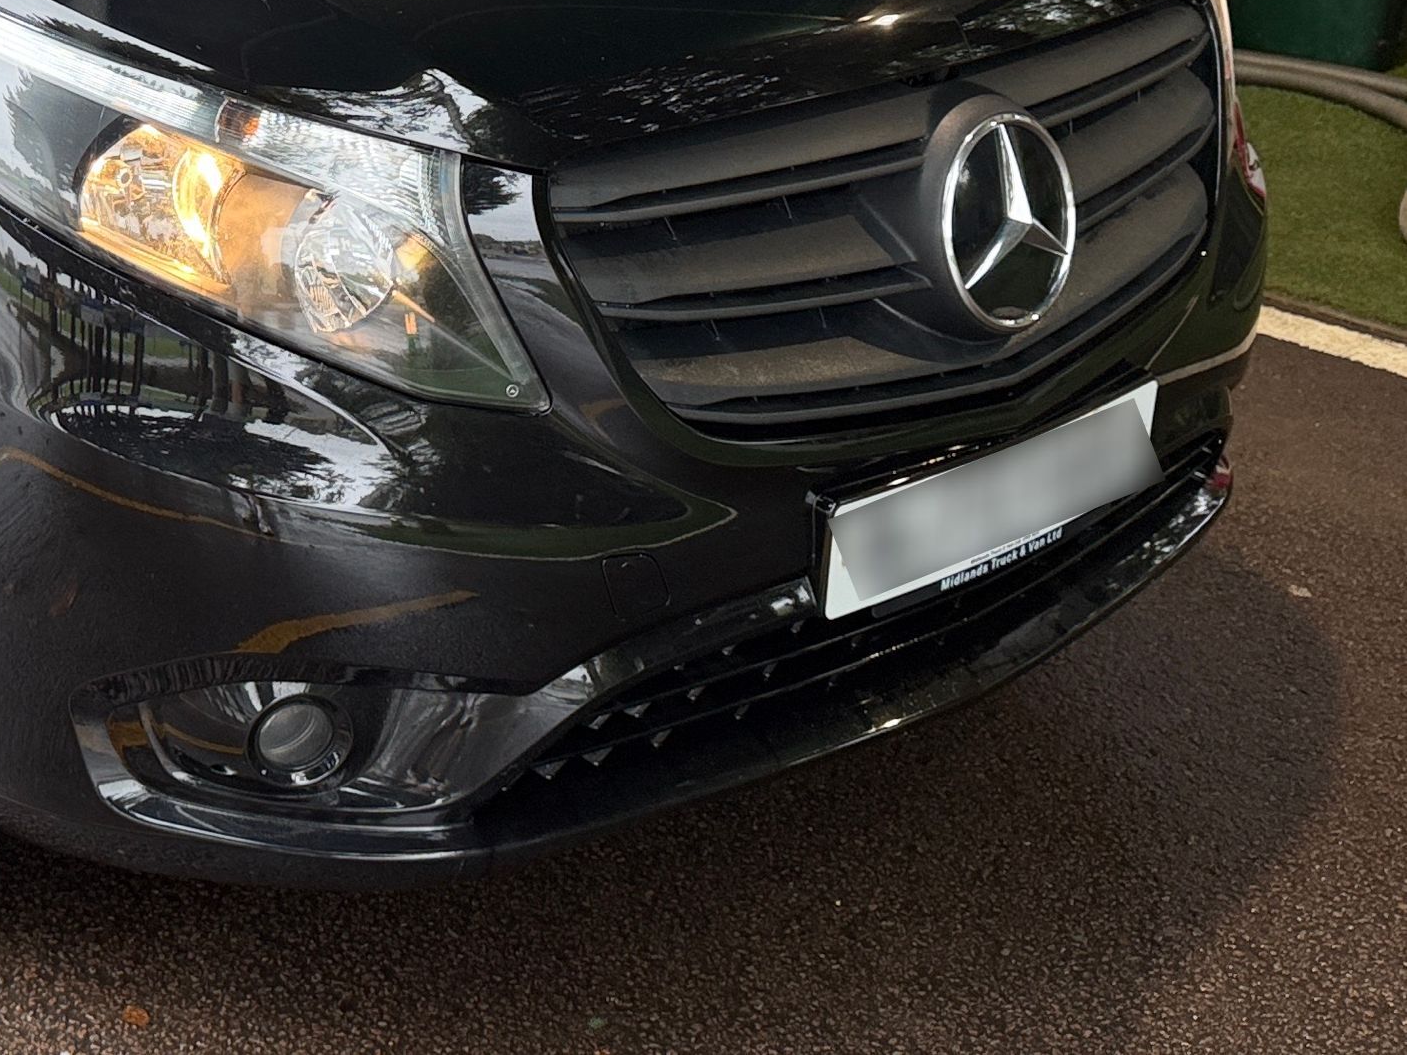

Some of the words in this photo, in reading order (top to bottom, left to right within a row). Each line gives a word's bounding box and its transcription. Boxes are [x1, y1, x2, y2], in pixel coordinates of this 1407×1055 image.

[940, 563, 989, 592] Midlands
[991, 549, 1018, 571] Truck
[1028, 536, 1046, 553] Van
[1046, 526, 1063, 545] Ltd
